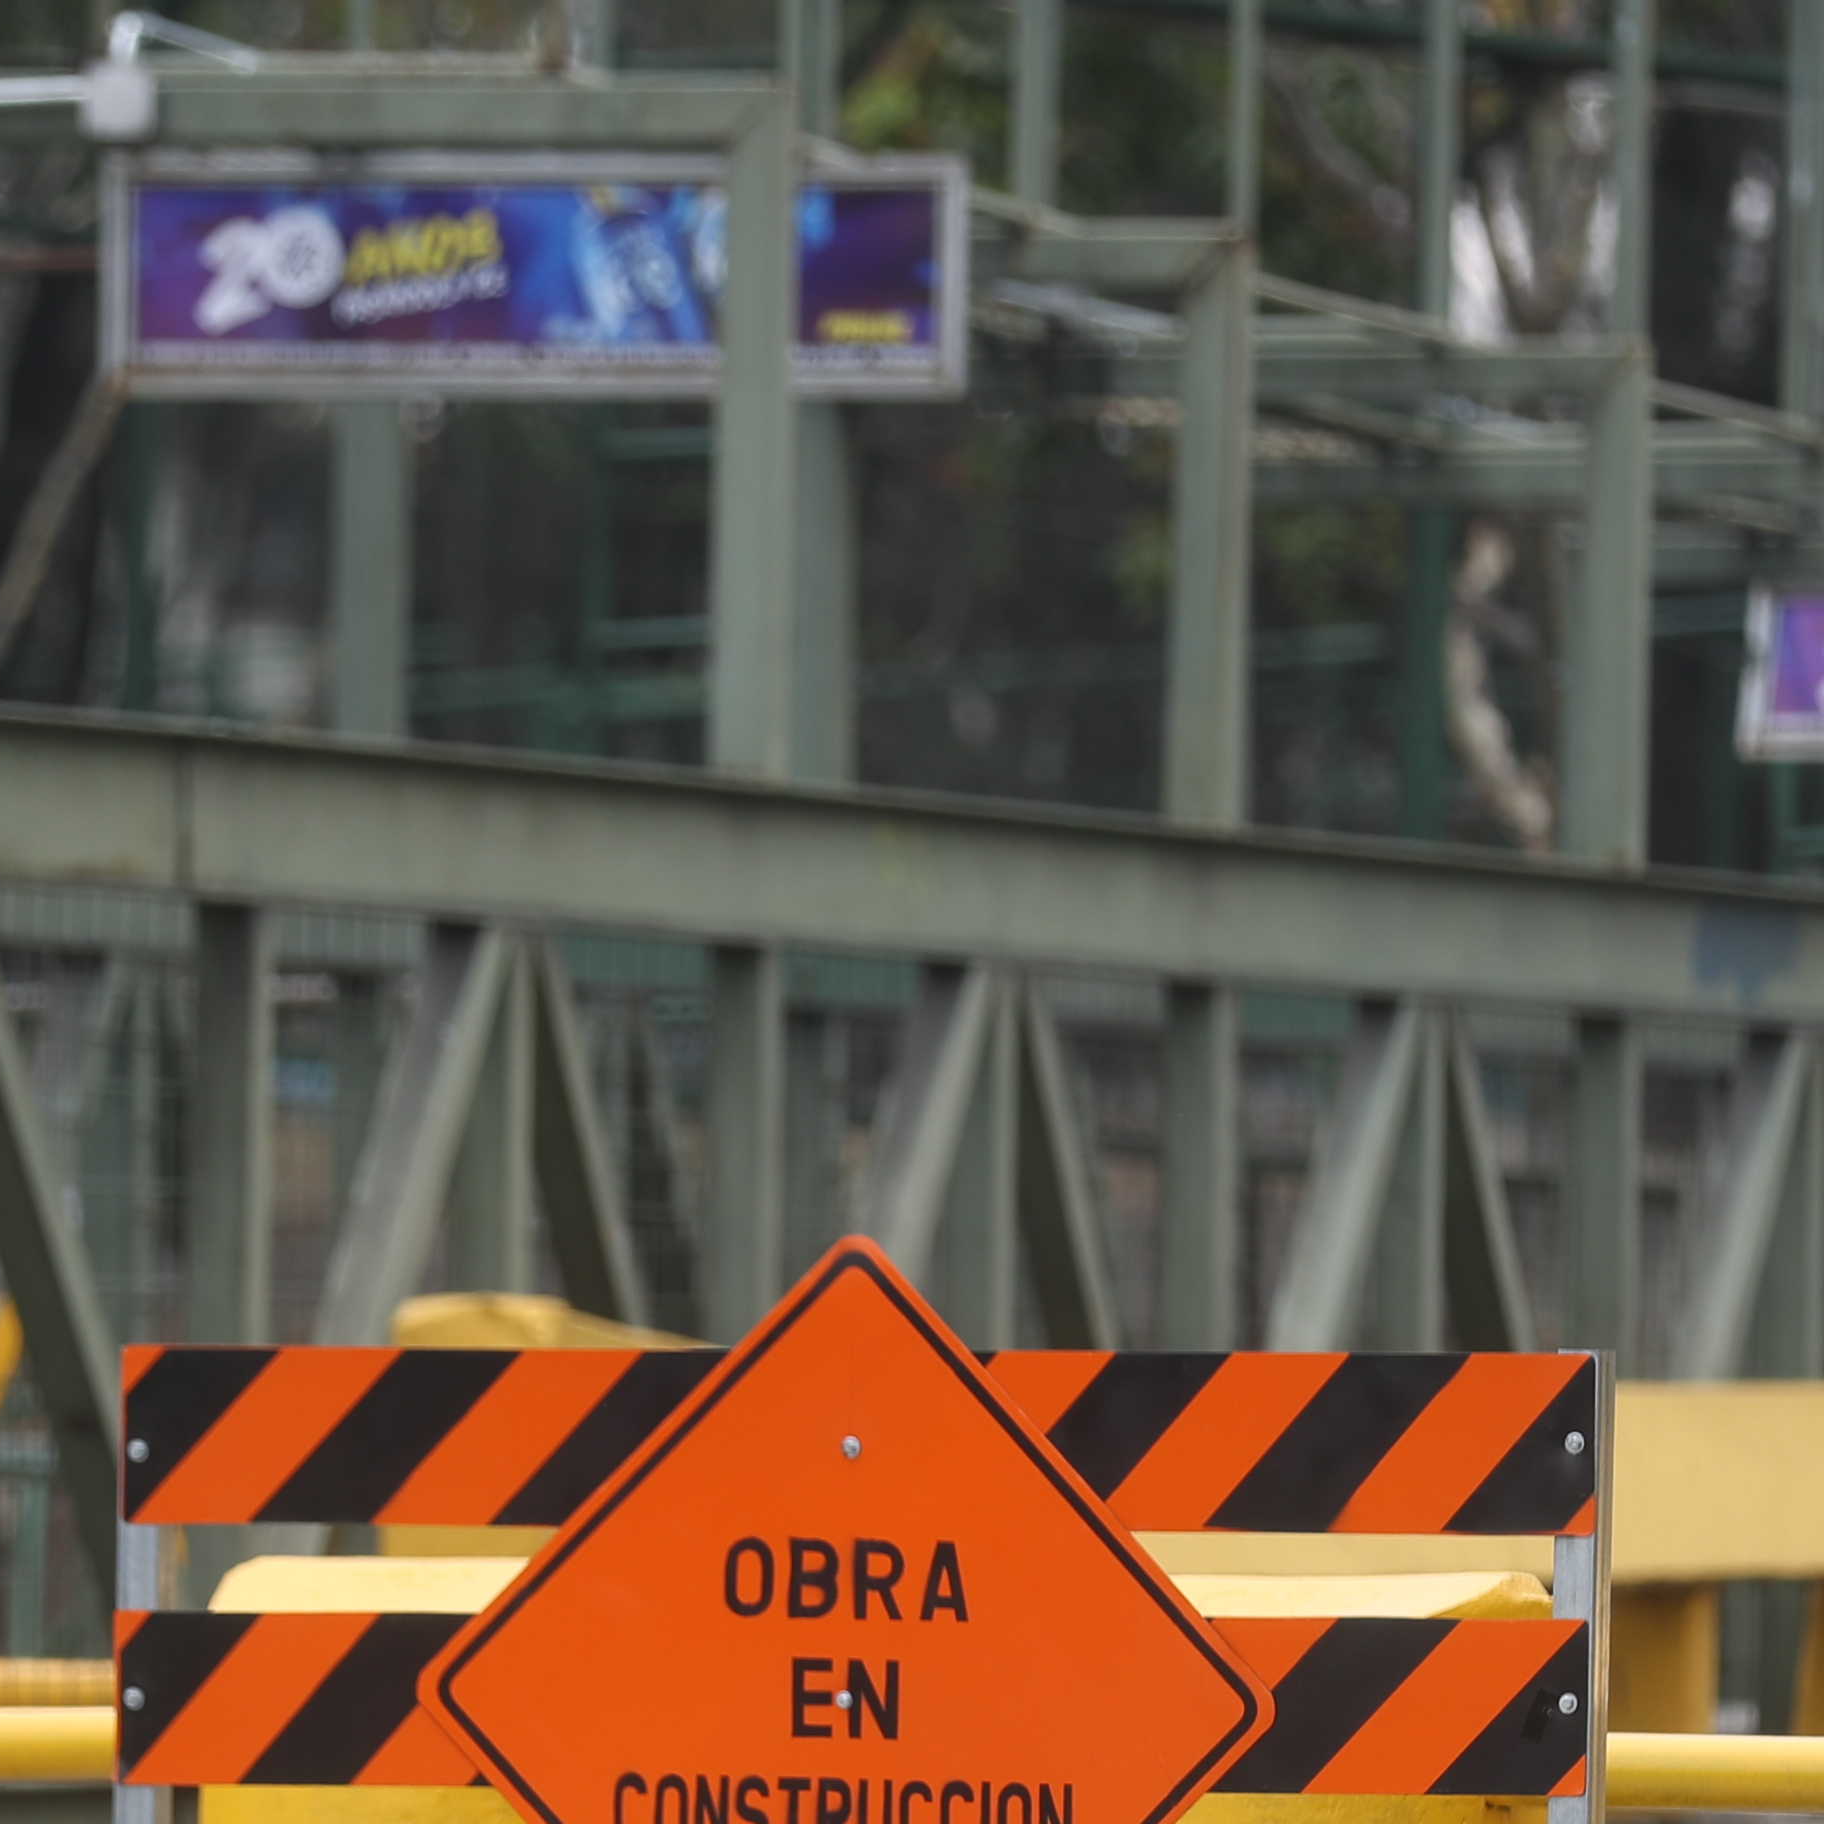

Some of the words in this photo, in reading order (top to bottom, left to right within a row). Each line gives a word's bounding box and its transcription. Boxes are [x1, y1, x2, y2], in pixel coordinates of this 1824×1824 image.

[193, 203, 344, 336] 20
[725, 1537, 968, 1622] OBRA
[792, 1657, 900, 1740] EN
